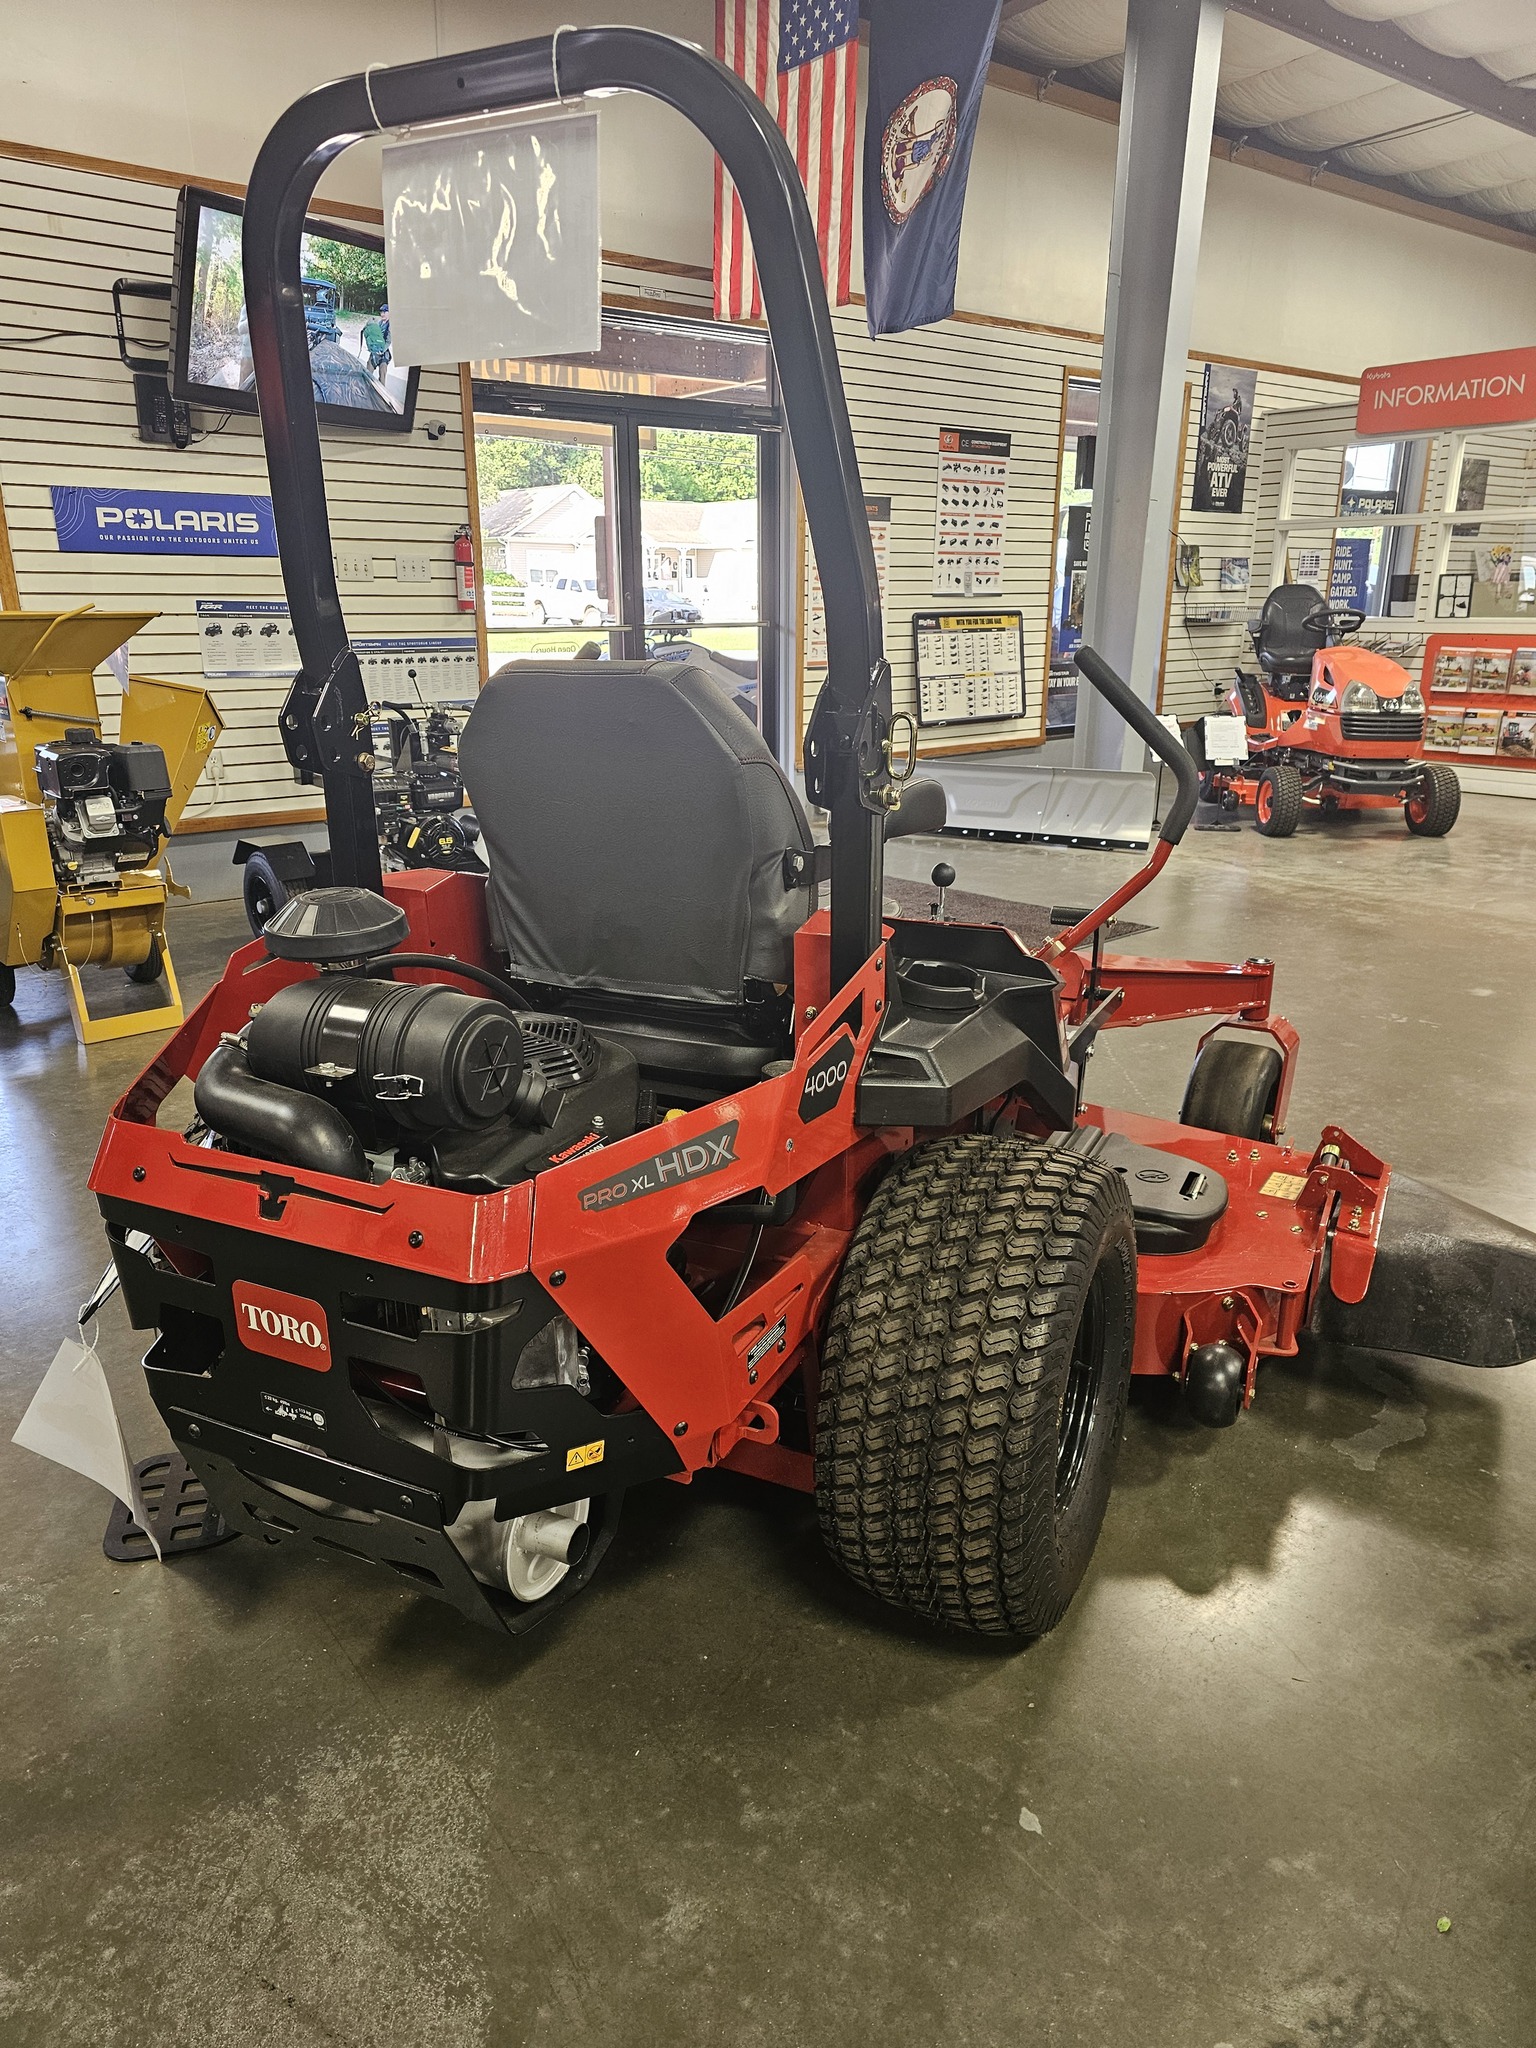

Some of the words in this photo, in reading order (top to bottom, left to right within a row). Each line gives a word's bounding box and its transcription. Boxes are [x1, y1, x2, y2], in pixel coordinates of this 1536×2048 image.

[1374, 374, 1526, 410] INFORMATION
[1207, 462, 1239, 473] POWERFUL
[1210, 472, 1233, 488] ATV
[1212, 488, 1228, 497] EVER
[1359, 498, 1395, 510] POLARIS
[96, 507, 260, 534] POLARIS
[1335, 546, 1352, 557] RIDE.
[1334, 560, 1353, 571] HUNT.
[1332, 573, 1352, 584] CAMP.
[1330, 586, 1358, 597] GATHER.
[439, 837, 453, 845] 6.5
[805, 1060, 848, 1097] 4000
[549, 1133, 600, 1163] Kawasaki
[582, 1183, 627, 1211] PRO
[631, 1175, 655, 1193] XL
[655, 1134, 736, 1183] HDX
